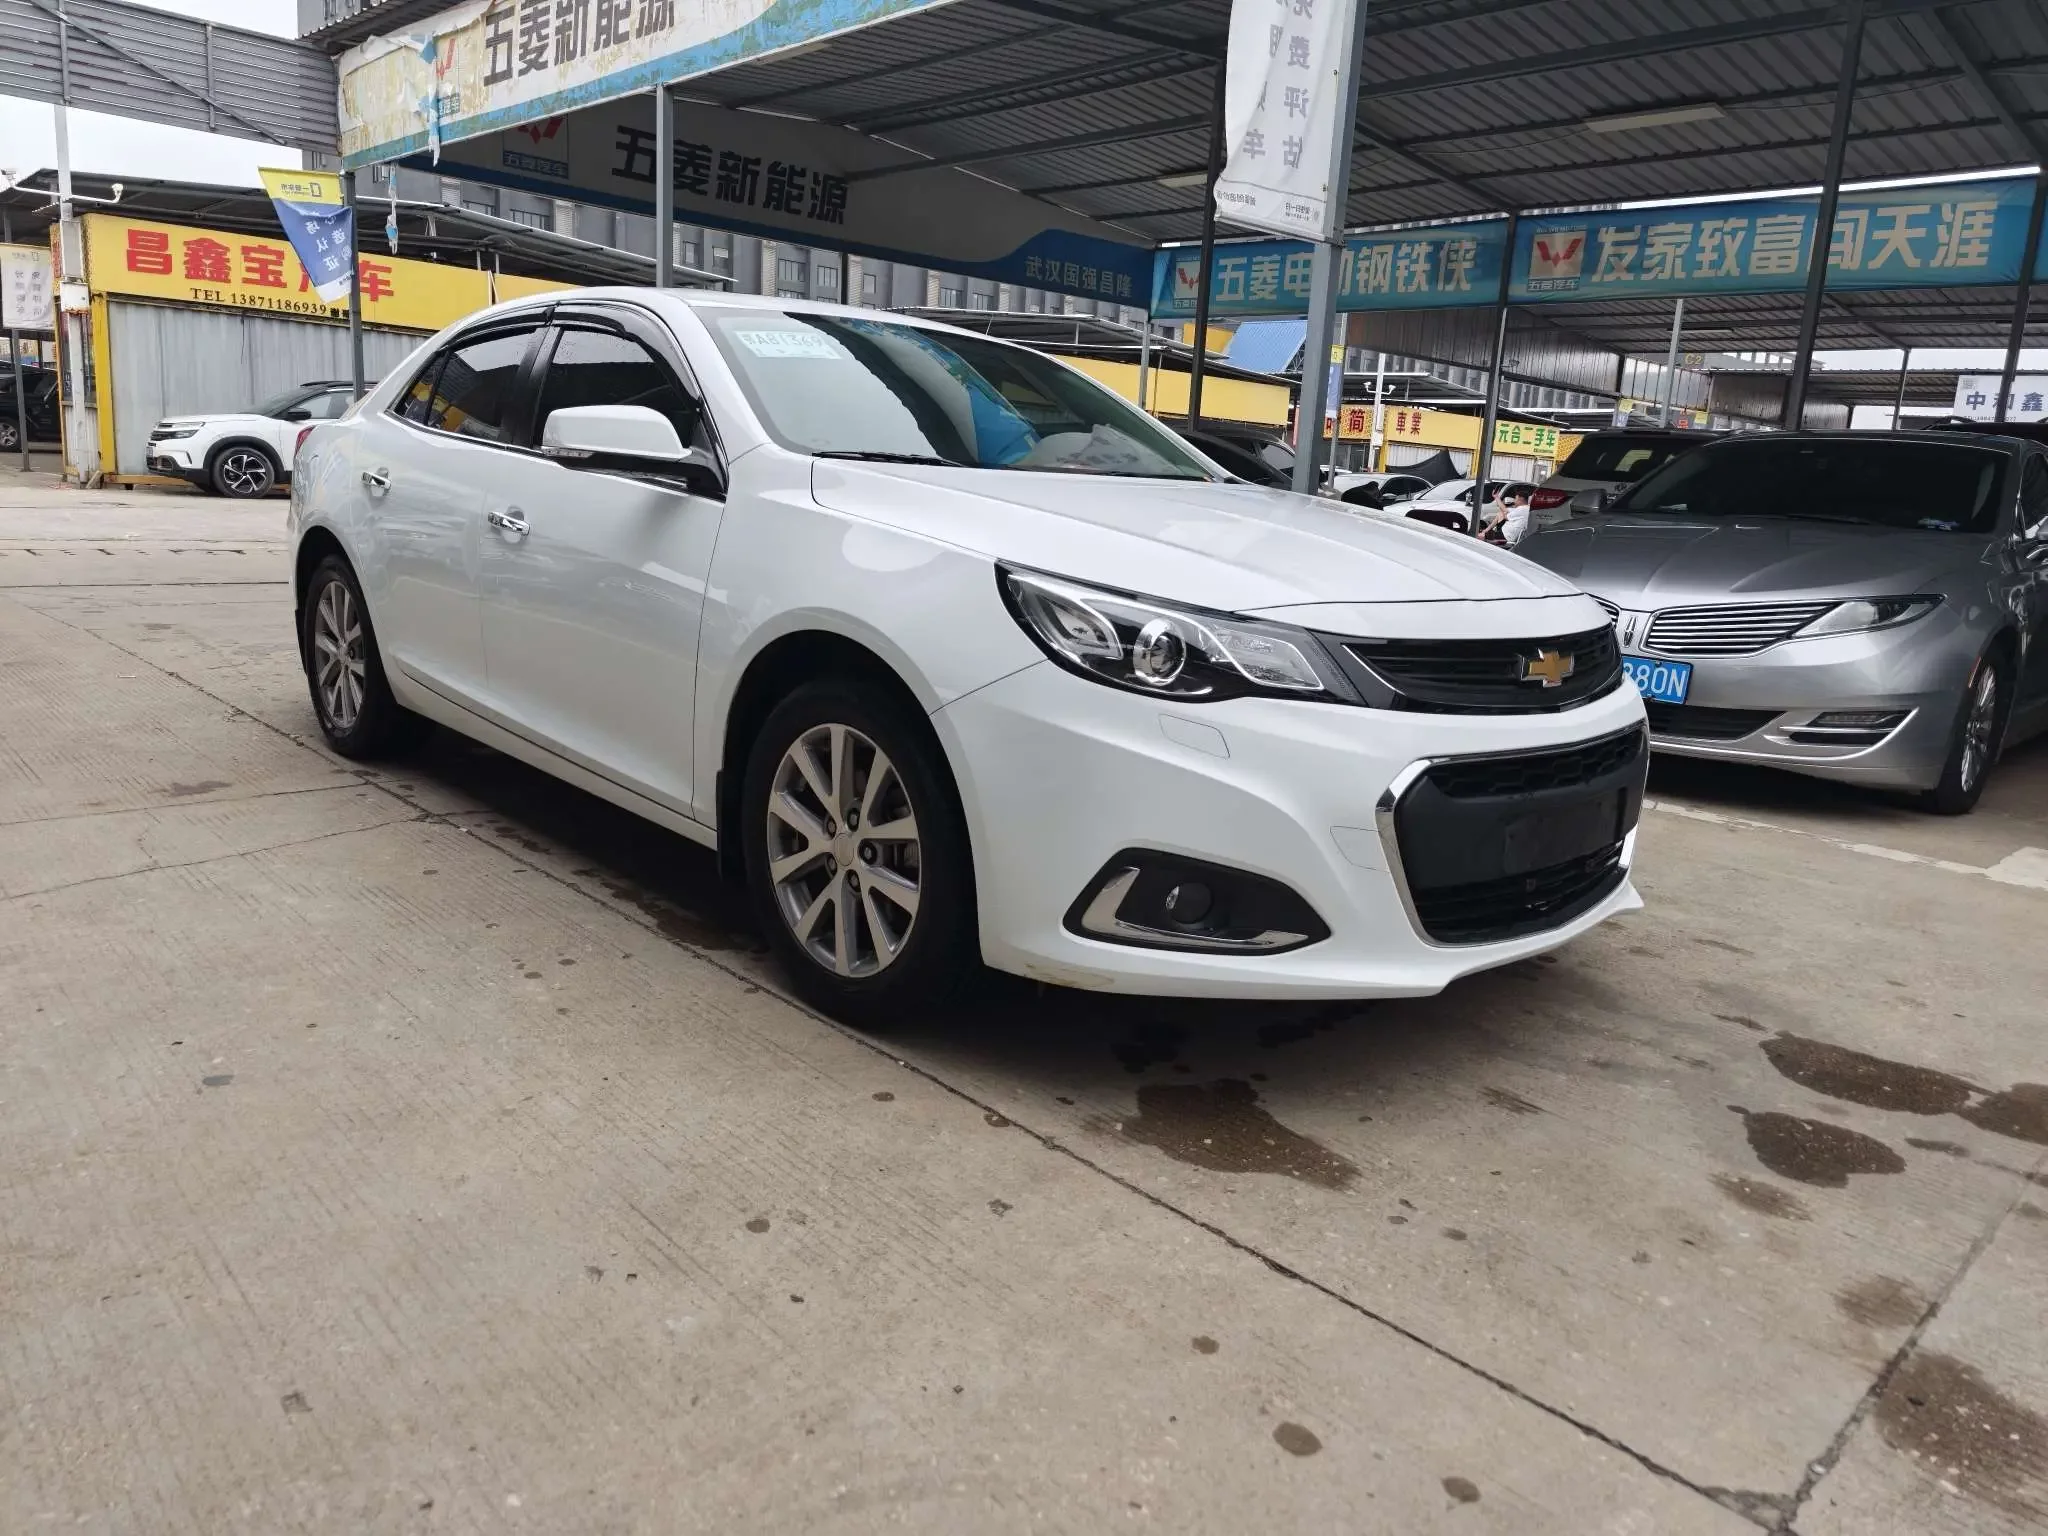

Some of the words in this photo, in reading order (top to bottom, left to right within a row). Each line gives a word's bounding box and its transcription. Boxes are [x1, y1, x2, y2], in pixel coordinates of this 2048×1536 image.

[611, 124, 848, 225] 五菱新能源
[126, 228, 394, 302] 昌鑫宝车
[1025, 255, 1133, 298] 武汉国强昌隆
[190, 287, 225, 303] TEL
[231, 292, 327, 315] 13871186939
